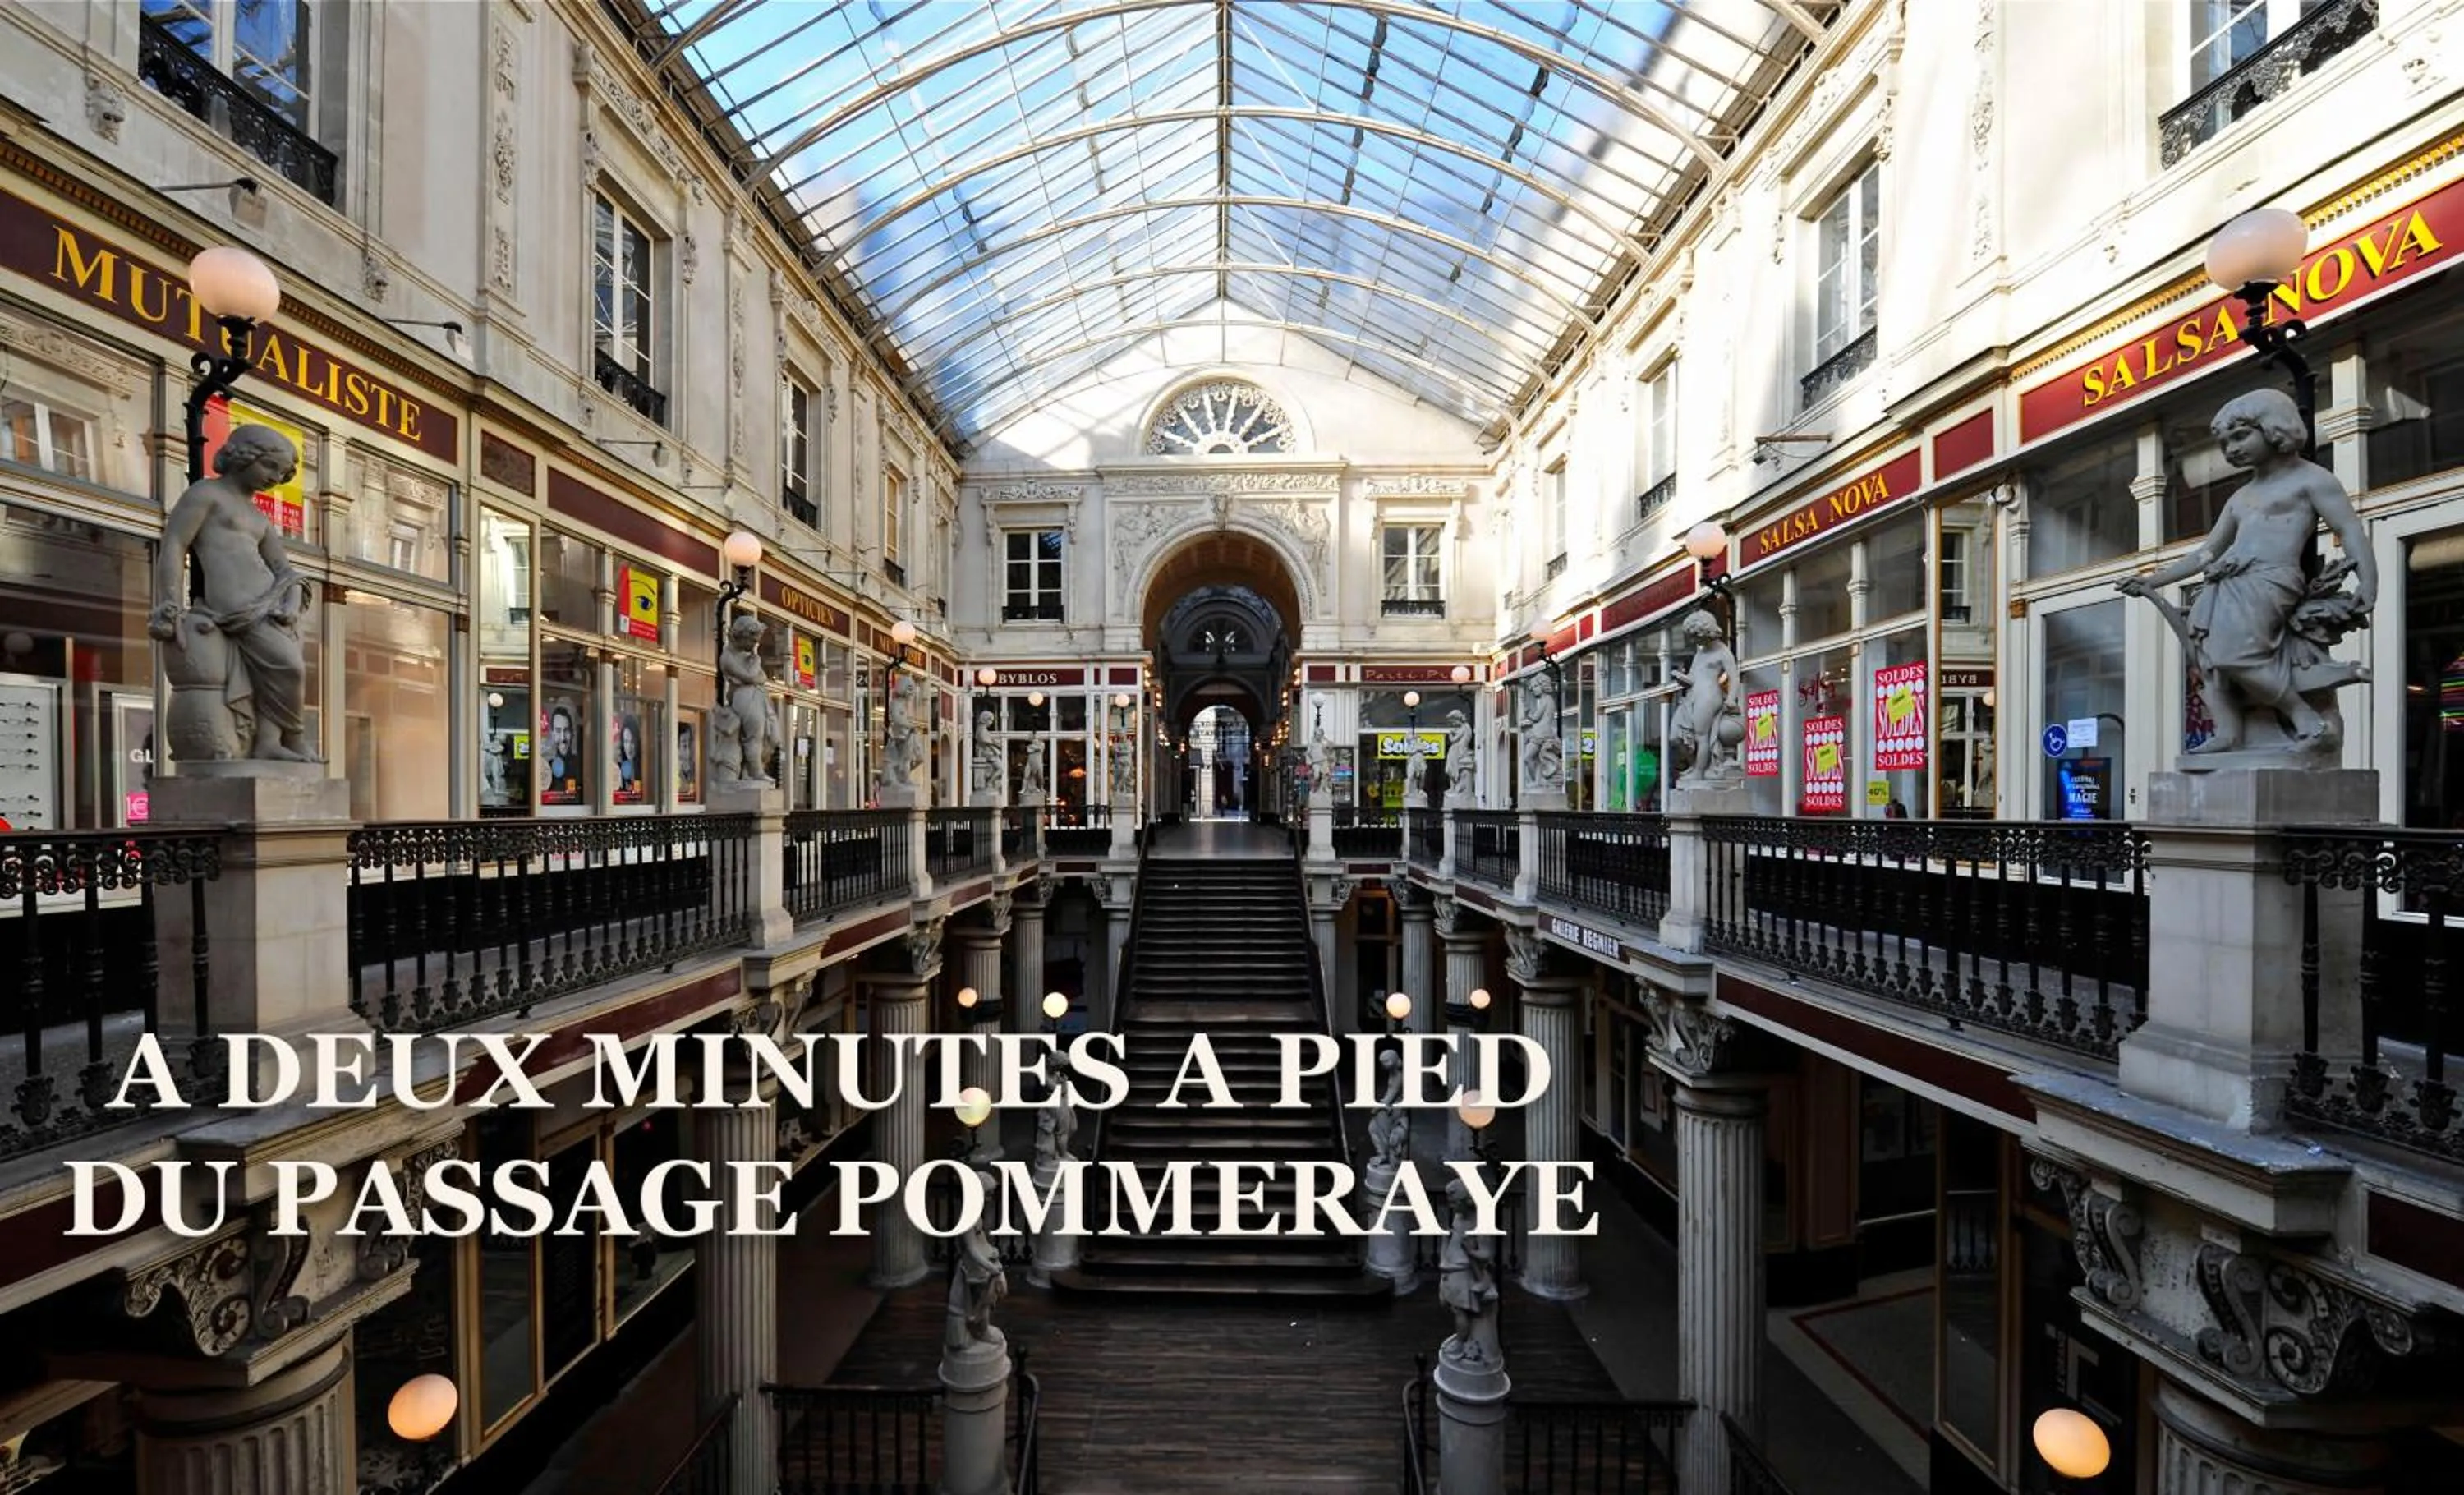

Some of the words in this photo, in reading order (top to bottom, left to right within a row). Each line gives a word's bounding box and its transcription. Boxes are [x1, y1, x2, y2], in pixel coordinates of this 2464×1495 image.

[2083, 304, 2239, 407] SALSA
[2263, 209, 2443, 327] NOVA
[1759, 511, 1818, 556] SALSA
[1828, 472, 1889, 524] NOVA
[781, 586, 835, 628] OPTICIEN
[998, 673, 1058, 684] BYBLOS
[1878, 664, 1924, 684] SOLDES
[1748, 693, 1778, 707] SOLDES
[1806, 719, 1844, 734] SOLDES
[1381, 736, 1440, 754] Soles
[1748, 761, 1778, 773] SOLDES
[1878, 752, 1924, 767] SOLDES
[1806, 794, 1844, 807] SOLDES
